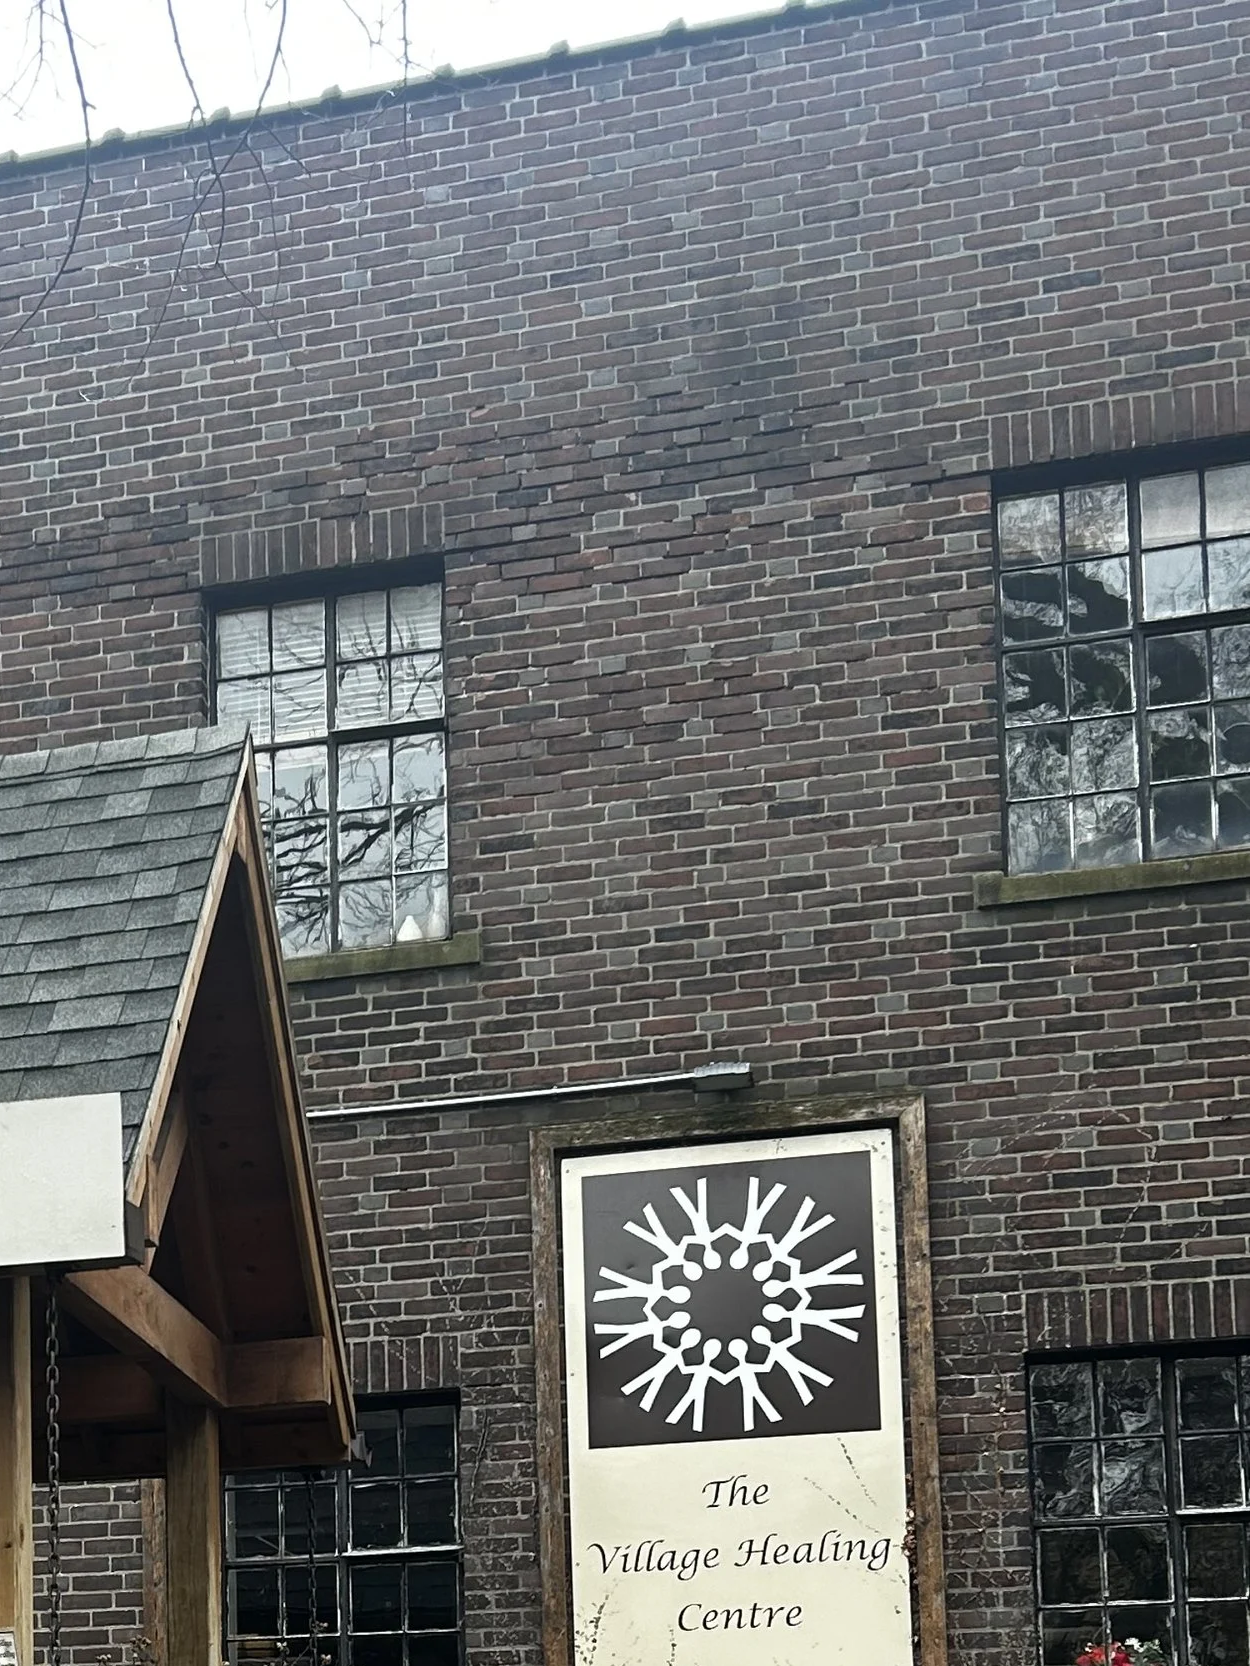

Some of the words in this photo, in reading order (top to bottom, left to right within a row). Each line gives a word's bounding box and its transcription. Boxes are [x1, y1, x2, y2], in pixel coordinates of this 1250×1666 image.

[701, 1474, 771, 1508] The
[587, 1538, 720, 1581] Village
[734, 1529, 891, 1571] Healing
[678, 1602, 803, 1632] Centre
